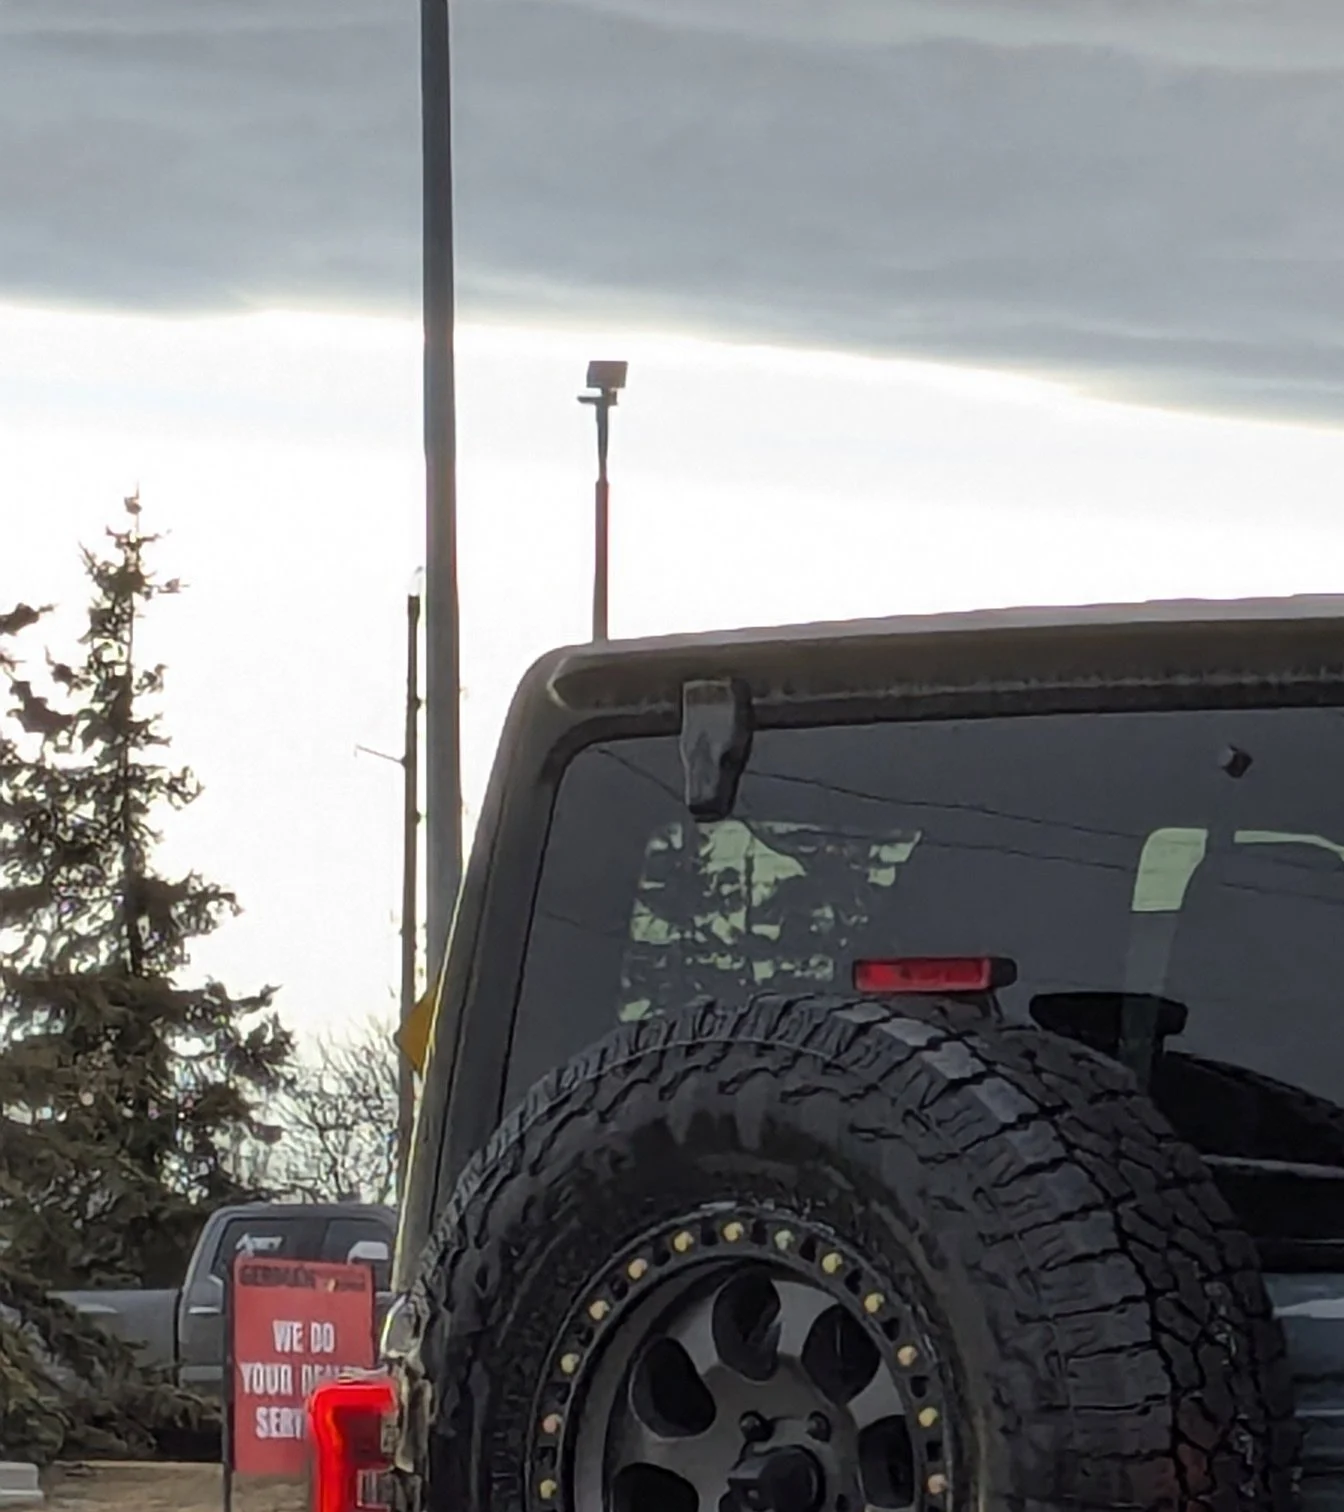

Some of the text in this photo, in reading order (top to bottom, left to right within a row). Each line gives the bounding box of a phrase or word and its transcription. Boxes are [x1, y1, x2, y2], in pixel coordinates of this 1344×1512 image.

[273, 1320, 335, 1353] WE DO
[239, 1361, 293, 1396] YOUR
